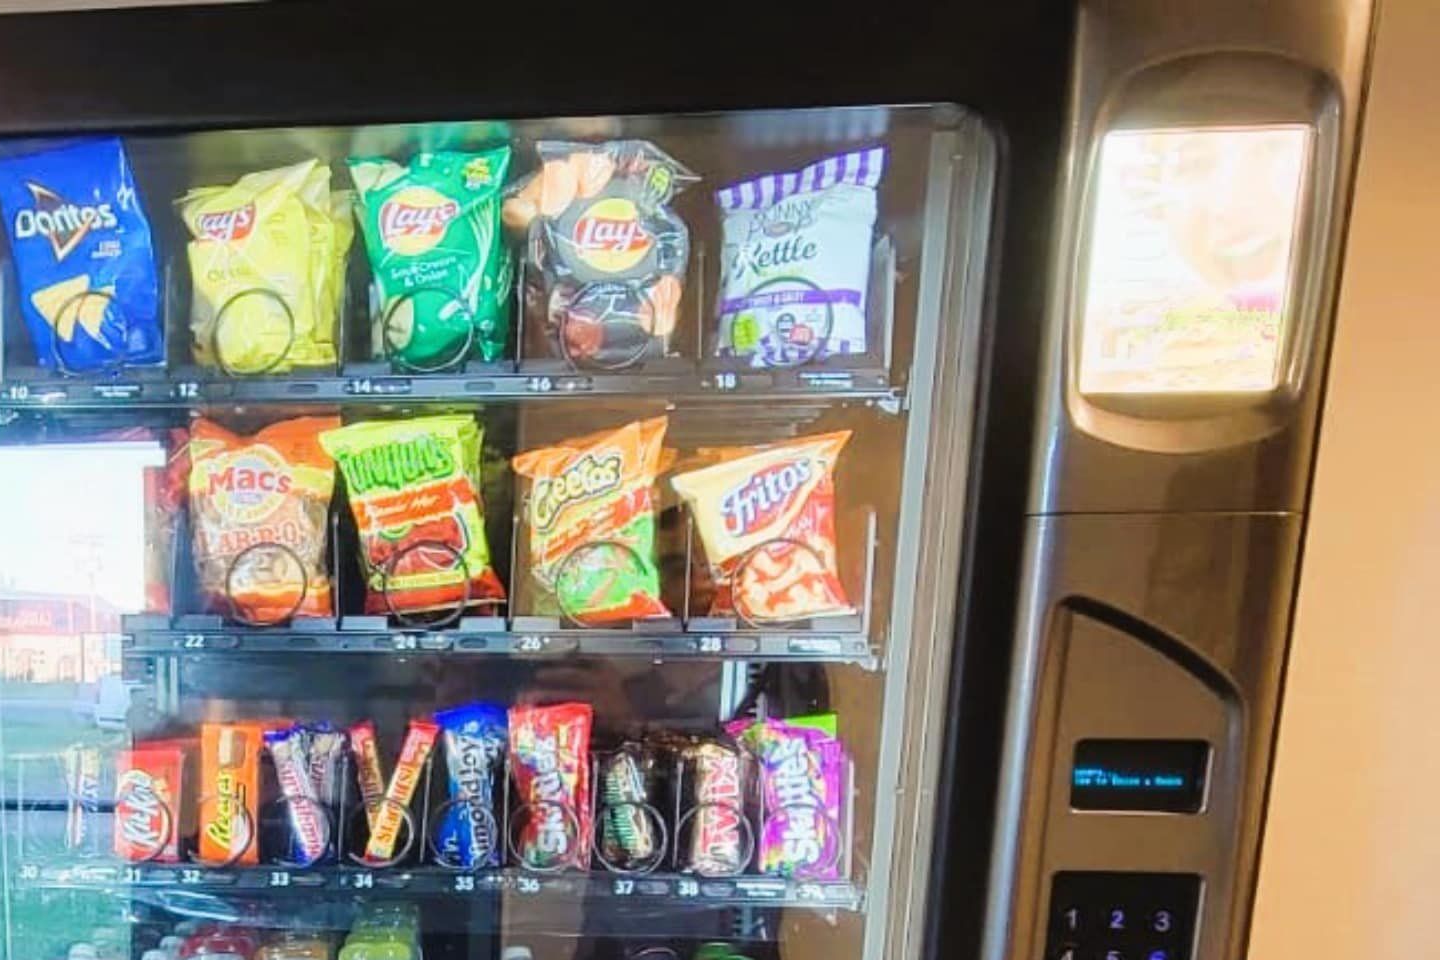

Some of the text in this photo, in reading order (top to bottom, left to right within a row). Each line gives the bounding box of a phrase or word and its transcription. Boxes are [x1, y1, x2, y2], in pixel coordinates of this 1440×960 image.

[14, 202, 118, 239] Doritos
[731, 236, 817, 280] Kettle
[352, 379, 371, 393] 14
[531, 377, 551, 392] 16
[715, 374, 737, 389] 18
[10, 386, 28, 399] 10
[179, 383, 198, 397] 12
[720, 457, 812, 538] Fritos
[183, 634, 205, 648] 22
[394, 635, 416, 650] 24
[521, 637, 541, 651] 26
[700, 638, 722, 652] 28
[182, 869, 201, 884] 32
[270, 871, 289, 886] 33
[353, 874, 373, 888] 34
[455, 876, 474, 890] 35
[520, 878, 540, 892] 36
[614, 880, 634, 894] 37
[678, 880, 698, 895] 38
[1067, 908, 1078, 928] 1
[1110, 909, 1125, 929] 2
[1154, 911, 1170, 932] 3
